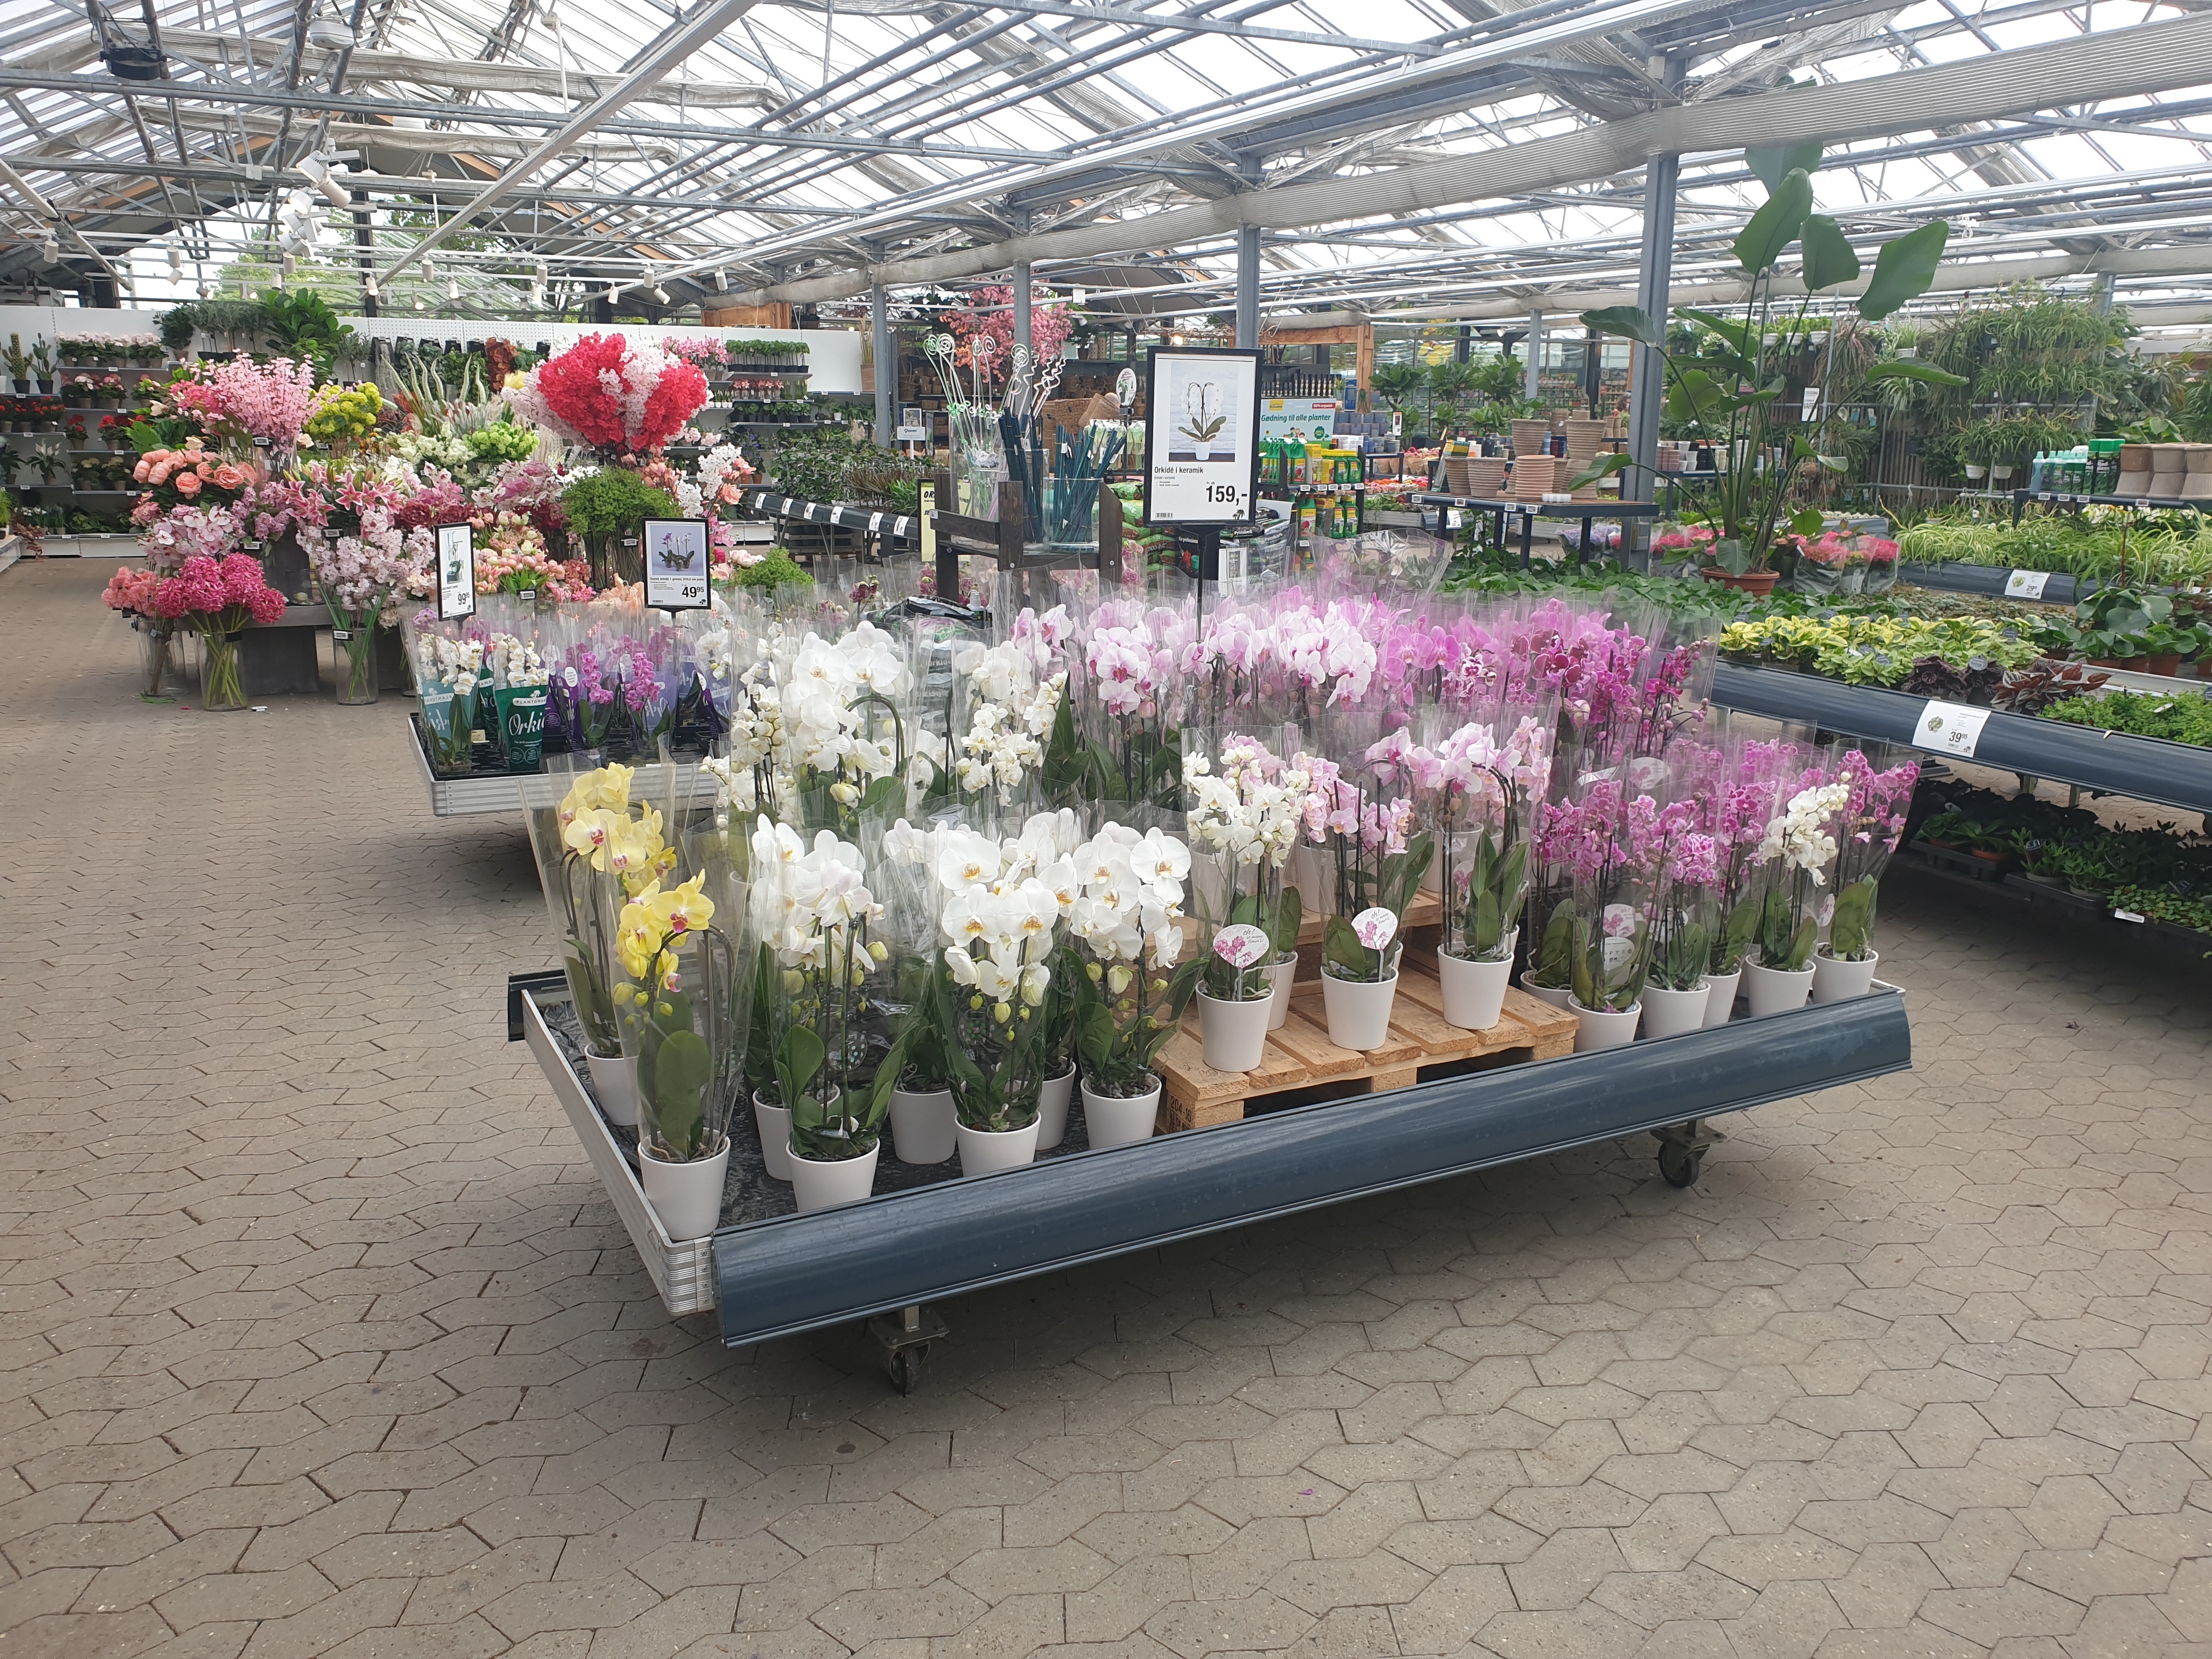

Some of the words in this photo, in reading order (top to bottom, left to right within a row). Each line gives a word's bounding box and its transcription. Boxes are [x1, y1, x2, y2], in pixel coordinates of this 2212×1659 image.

[1308, 414, 1331, 422] planter
[1206, 486, 1248, 506] 159,-
[1170, 1095, 1192, 1122] 204-16
